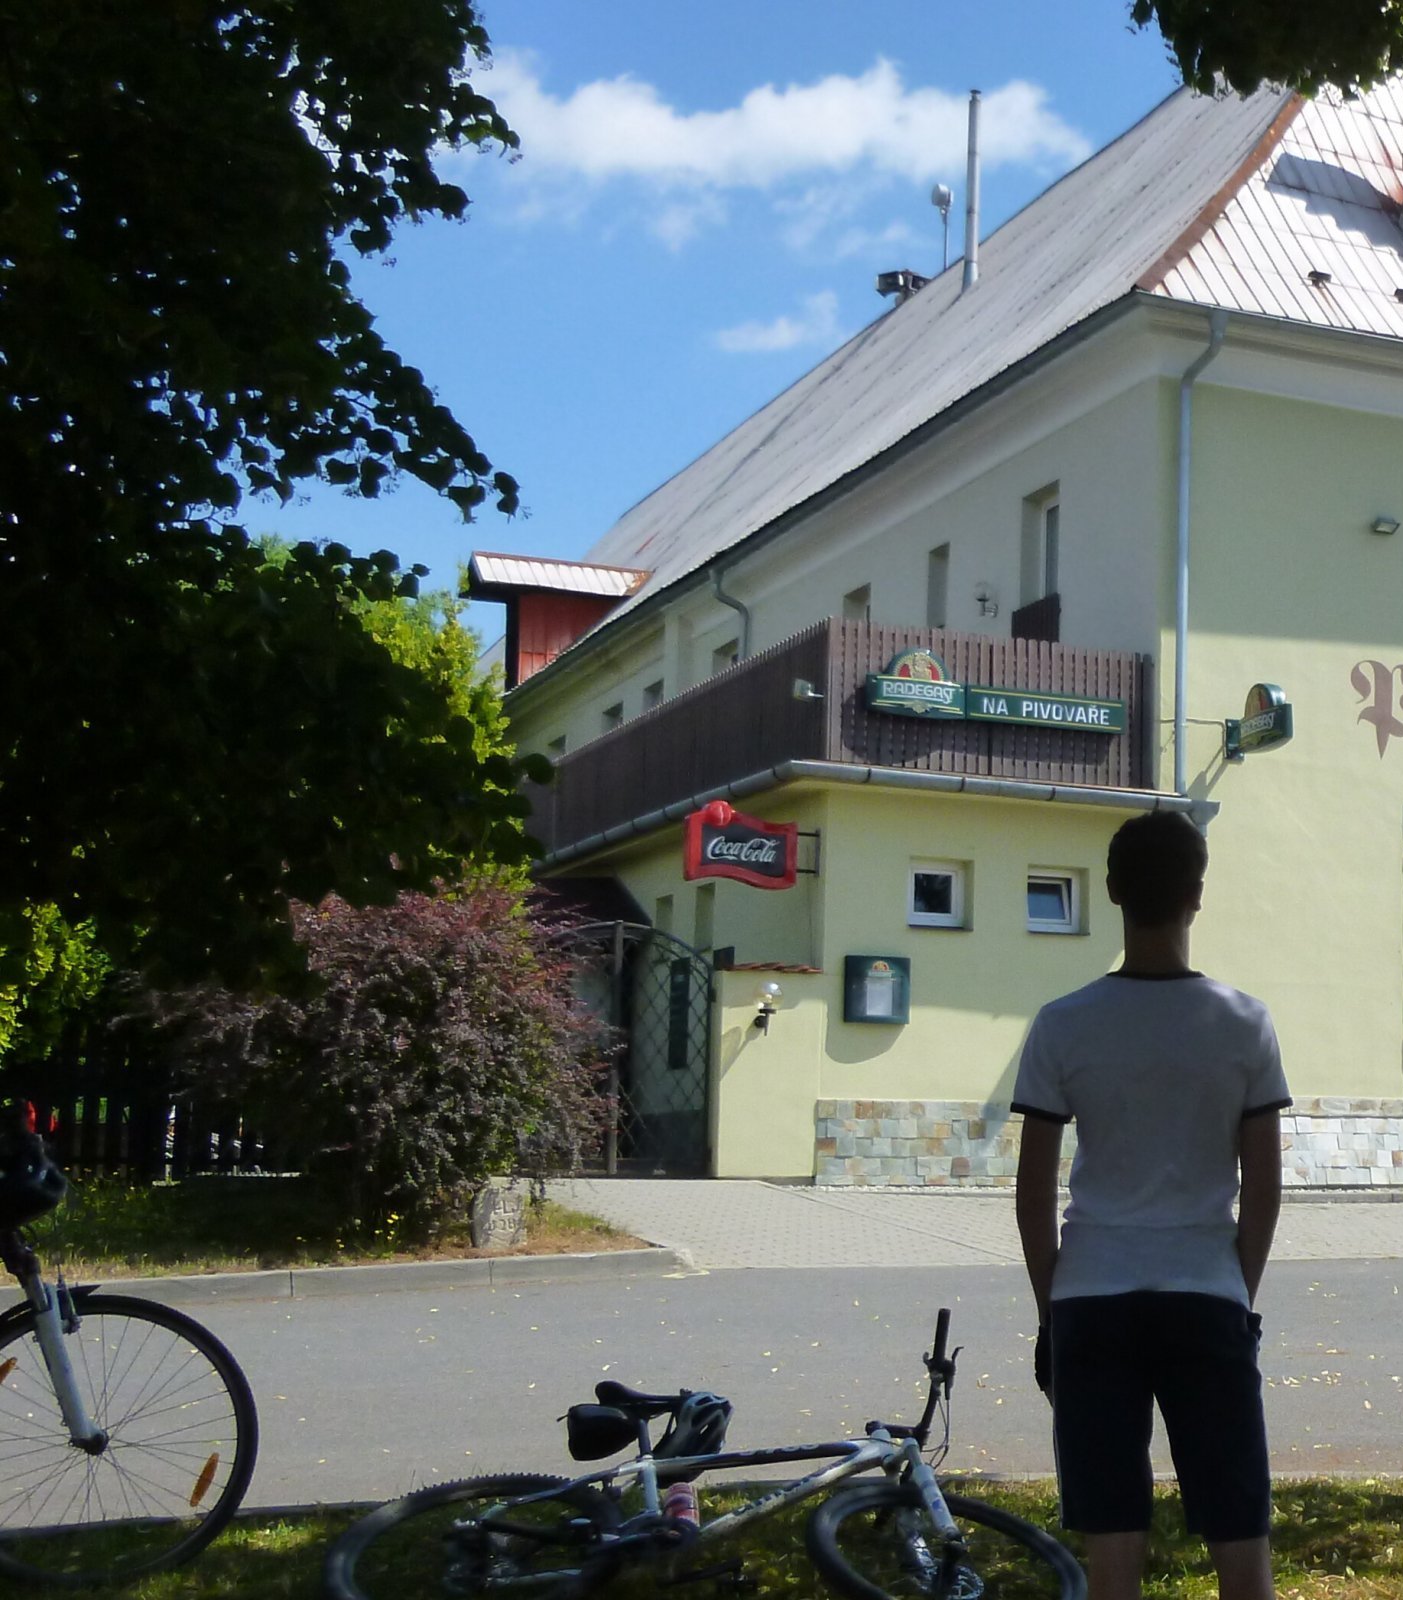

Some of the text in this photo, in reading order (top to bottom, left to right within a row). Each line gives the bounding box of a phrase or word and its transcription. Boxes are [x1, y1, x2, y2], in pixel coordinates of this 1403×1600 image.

[883, 681, 955, 704] RADEGAST
[983, 697, 1110, 726] NA PIVOVAŘE
